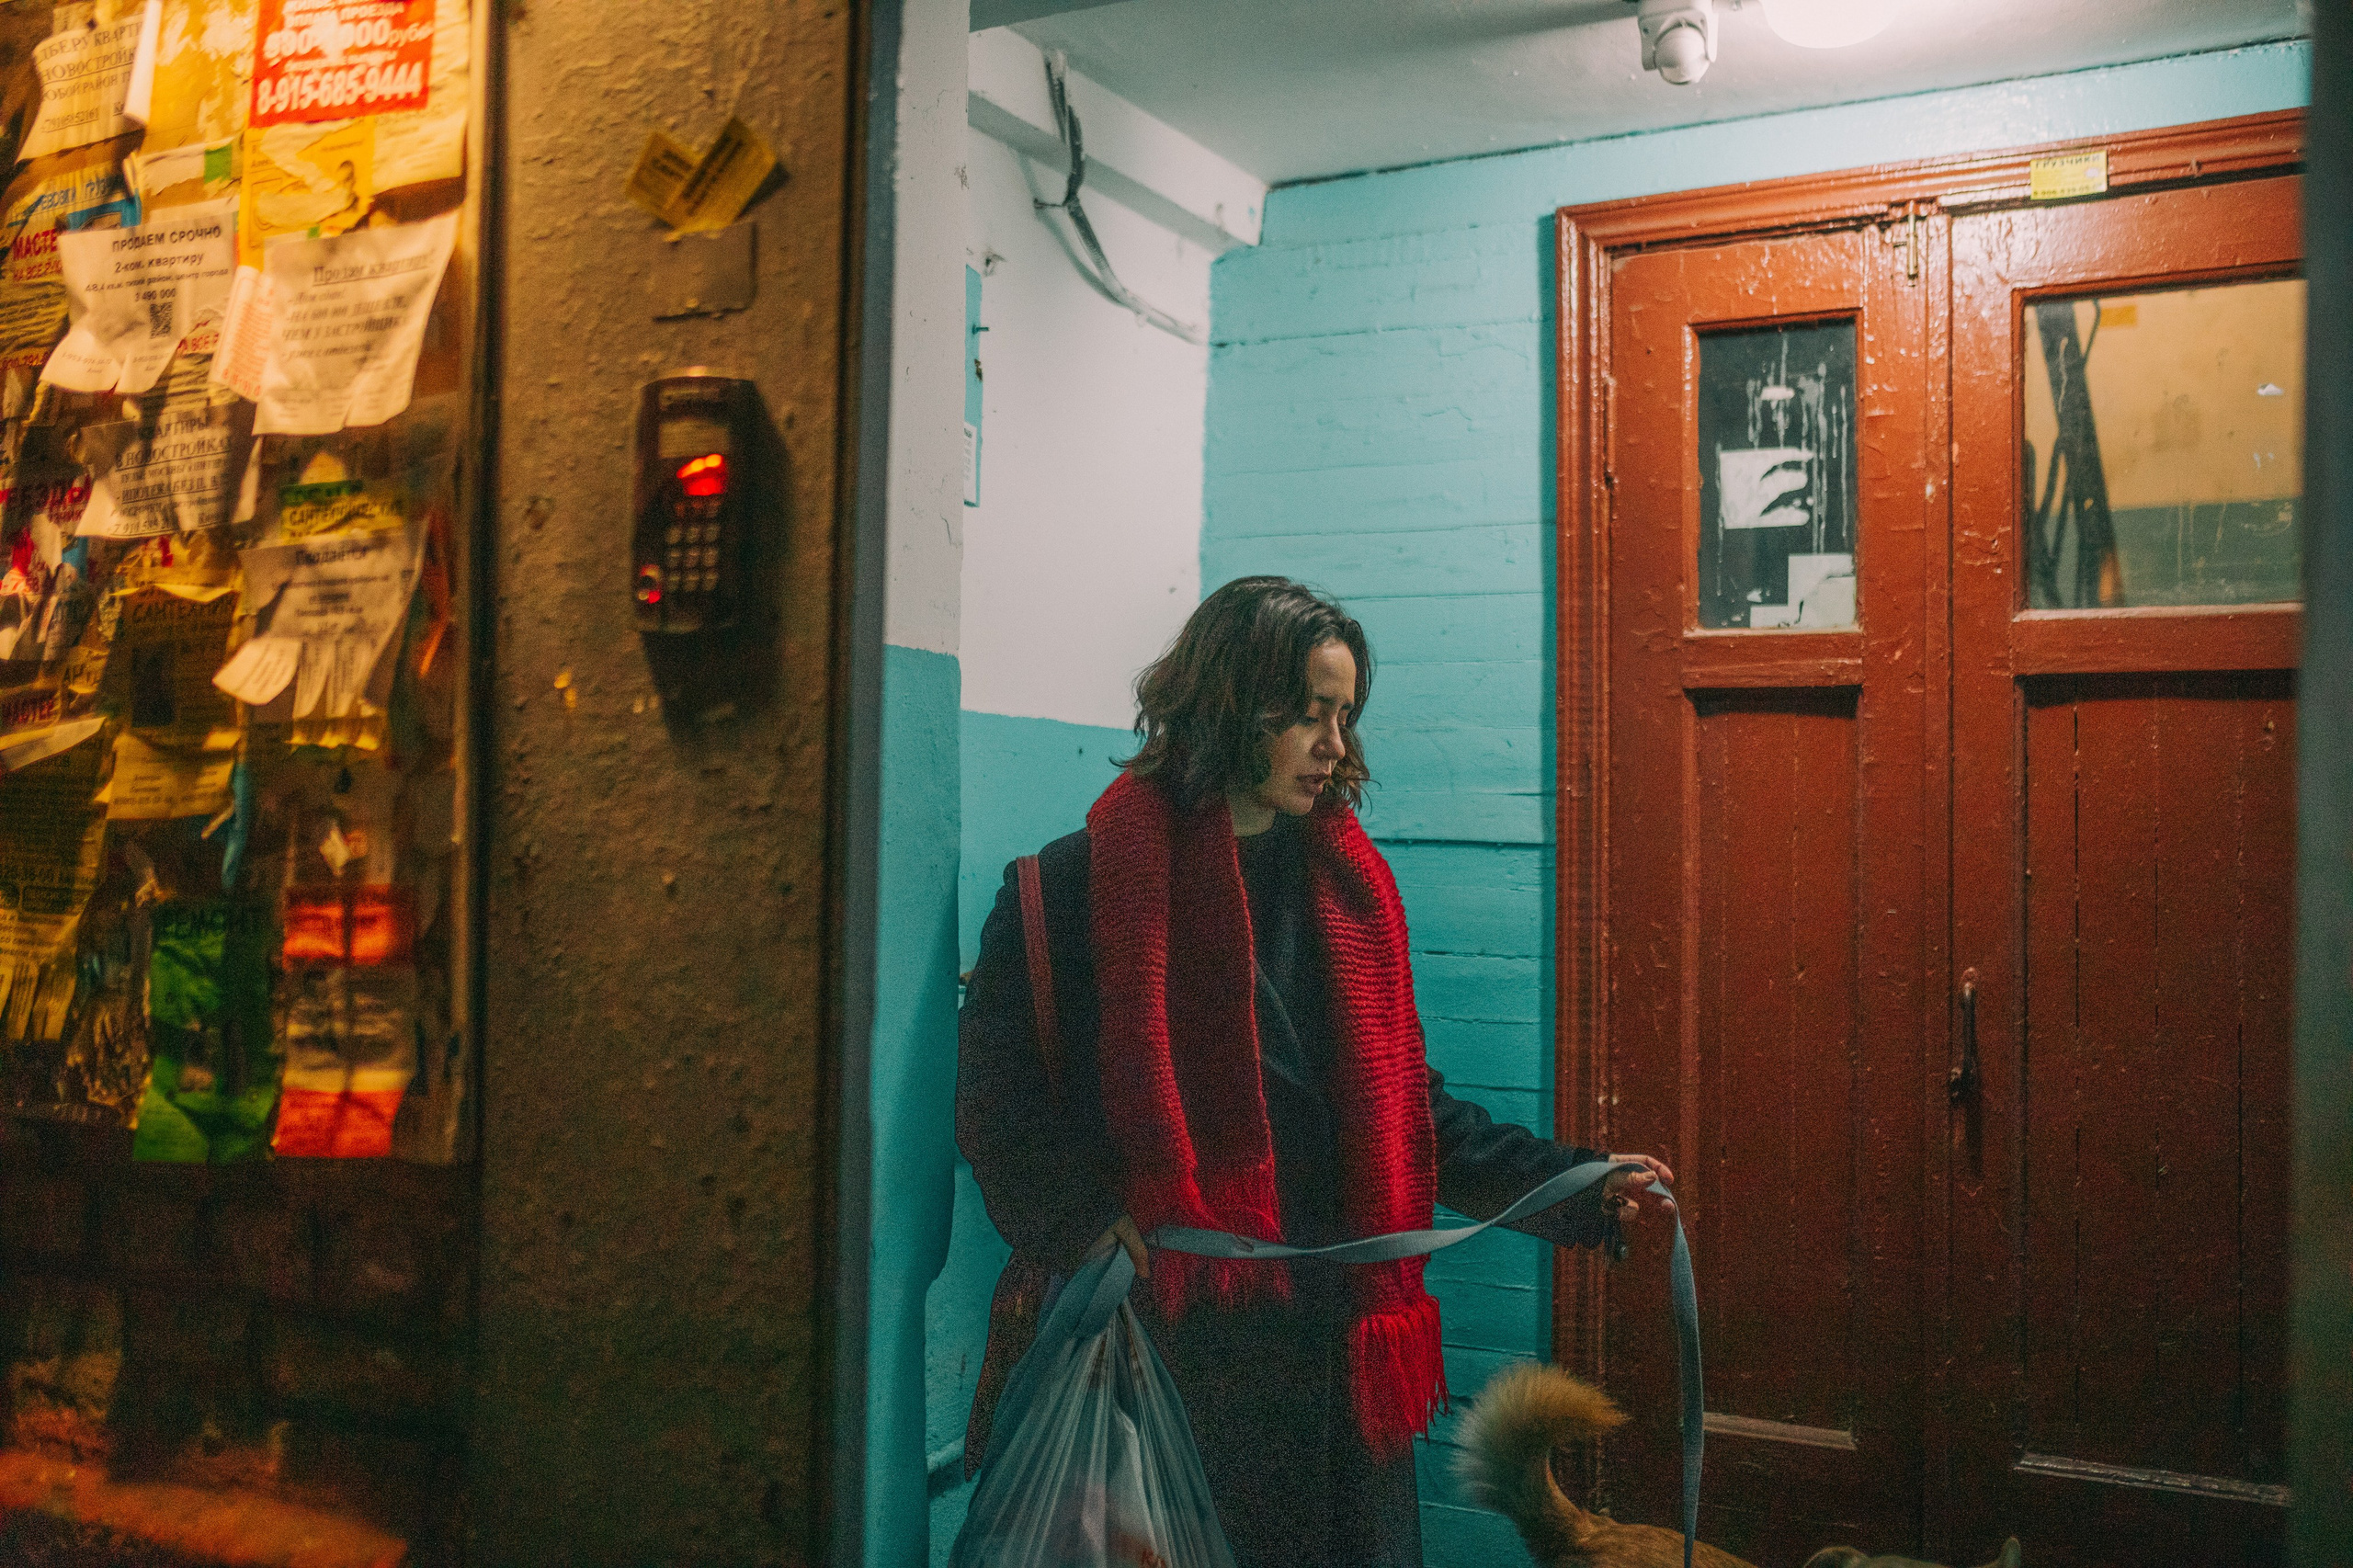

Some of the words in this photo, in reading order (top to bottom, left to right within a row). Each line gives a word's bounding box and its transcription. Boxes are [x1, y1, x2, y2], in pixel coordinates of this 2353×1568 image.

[256, 61, 424, 116] 8-915-685-9444
[13, 228, 58, 261] МАСТЕ
[111, 233, 165, 253] ПРОДАЕМ
[169, 225, 222, 244] СРОЧНО
[148, 253, 204, 268] квартиру
[160, 288, 176, 299] 000
